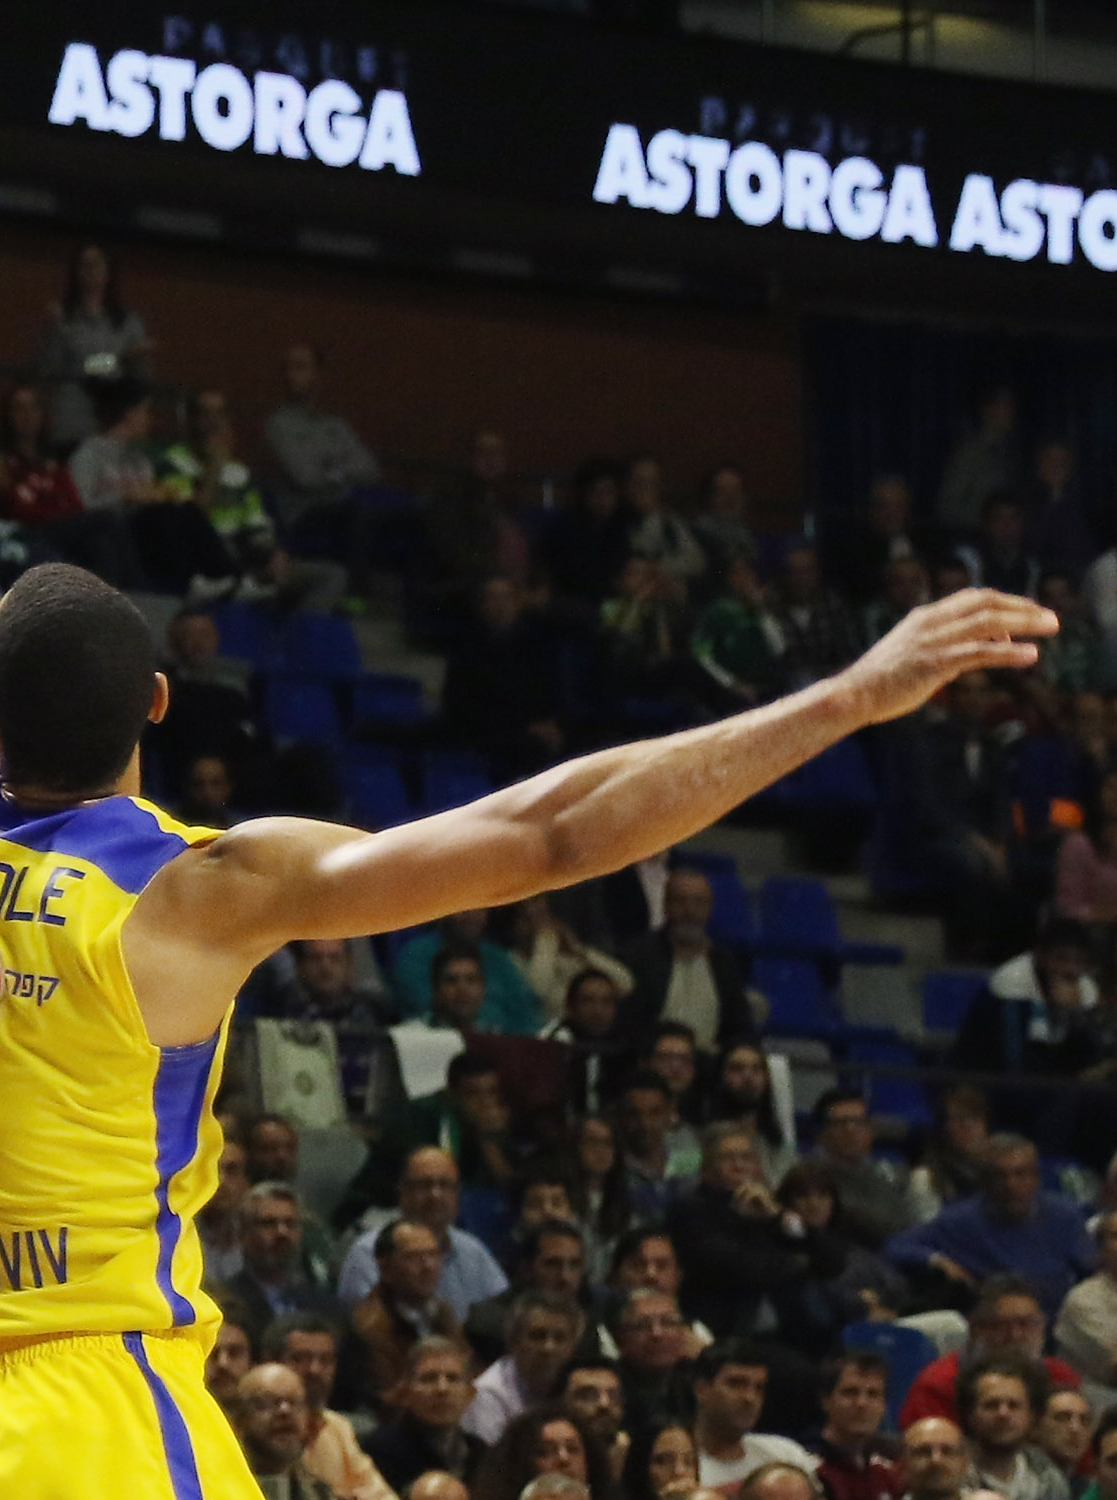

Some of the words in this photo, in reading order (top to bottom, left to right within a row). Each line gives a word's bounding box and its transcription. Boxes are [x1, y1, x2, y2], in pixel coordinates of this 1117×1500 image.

[48, 42, 422, 177] ASTORGA
[592, 122, 938, 248] ASTORGA
[948, 173, 1117, 271] ASTO
